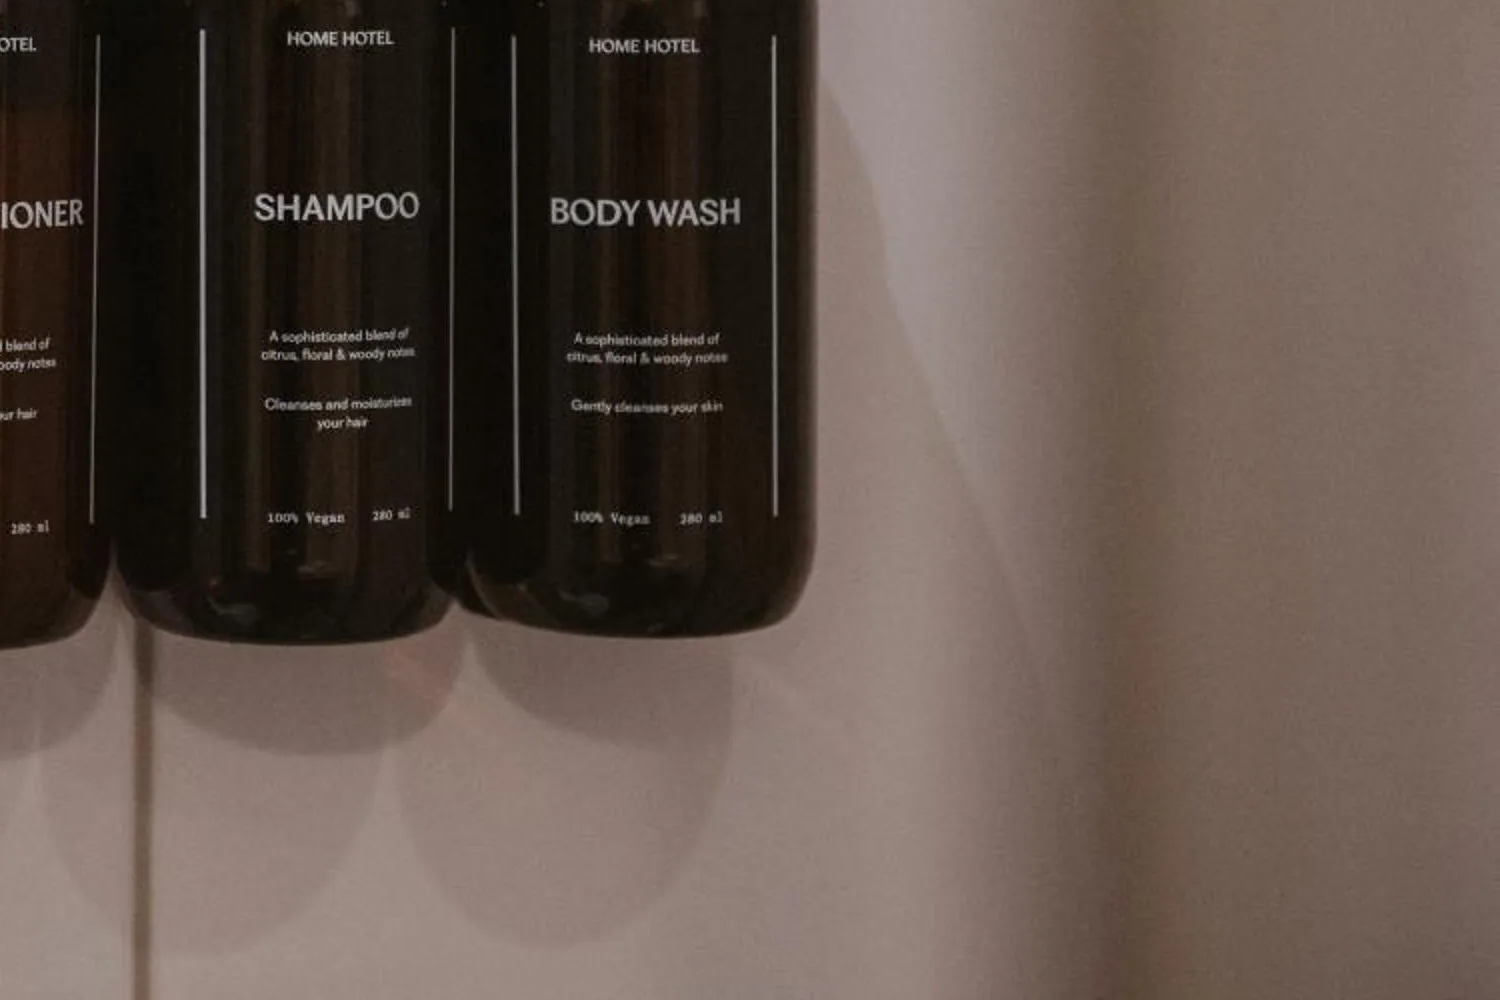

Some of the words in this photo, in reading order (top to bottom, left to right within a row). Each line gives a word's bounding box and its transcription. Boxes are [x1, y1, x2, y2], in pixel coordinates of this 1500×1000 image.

[288, 31, 338, 47] HOME
[343, 31, 394, 46] HOTEL
[589, 39, 640, 54] HOME
[645, 39, 700, 53] HOTEL
[254, 192, 420, 222] SHAMPOO
[551, 198, 640, 227] BODY
[648, 198, 741, 227] WASH
[269, 331, 279, 342] A
[281, 330, 362, 344] sophisticated
[366, 329, 396, 341] blend
[398, 328, 409, 339] of
[574, 333, 583, 344] A
[585, 333, 668, 347] sophisticated
[671, 334, 704, 345] blend
[707, 333, 720, 345] of
[6, 339, 36, 351] blend
[38, 338, 50, 350] of
[261, 350, 298, 361] citrus,
[302, 349, 332, 361] floral
[336, 349, 346, 361] &
[350, 348, 385, 361] woody
[606, 352, 636, 364] floral
[640, 353, 650, 364] &
[653, 353, 693, 367] woody
[696, 353, 728, 364] notes
[26, 358, 56, 369] notes
[265, 399, 323, 411] Cleanses
[325, 399, 348, 410] and
[572, 400, 612, 415] Gently
[615, 401, 668, 414] cleanses
[671, 403, 698, 416] your
[701, 400, 723, 412] skin
[16, 408, 37, 420] hair
[317, 418, 345, 432] your
[347, 417, 369, 428] hair
[268, 512, 299, 523] 100%
[306, 512, 345, 526] Vegan
[372, 510, 392, 521] 280
[574, 511, 603, 523] 100%
[611, 513, 650, 526] Vegan
[680, 513, 702, 525] 280
[11, 523, 31, 535] 280
